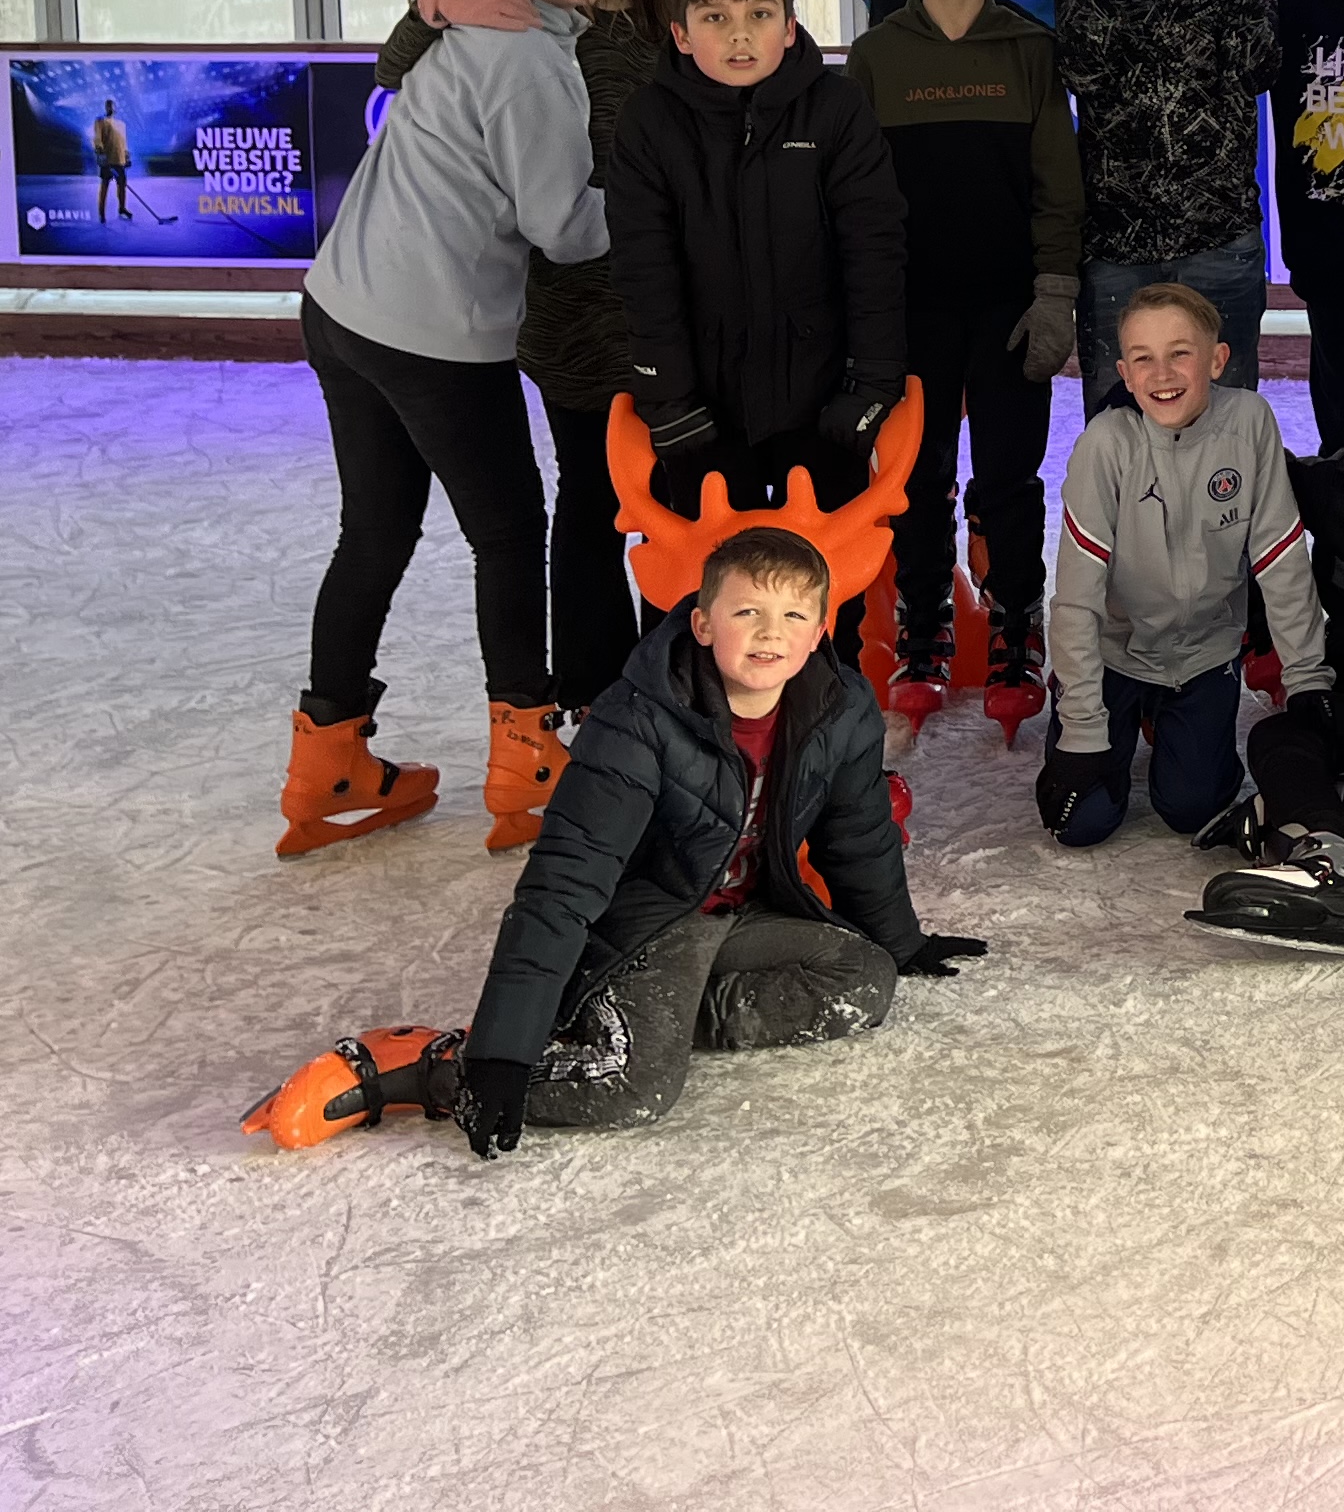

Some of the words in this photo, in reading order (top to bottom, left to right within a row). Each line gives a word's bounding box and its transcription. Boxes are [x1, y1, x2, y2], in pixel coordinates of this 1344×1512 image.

[196, 127, 293, 149] NIEUWE
[192, 149, 302, 171] WEBSITE
[204, 171, 294, 193] NODIG?
[198, 195, 305, 216] DARVIS.NL
